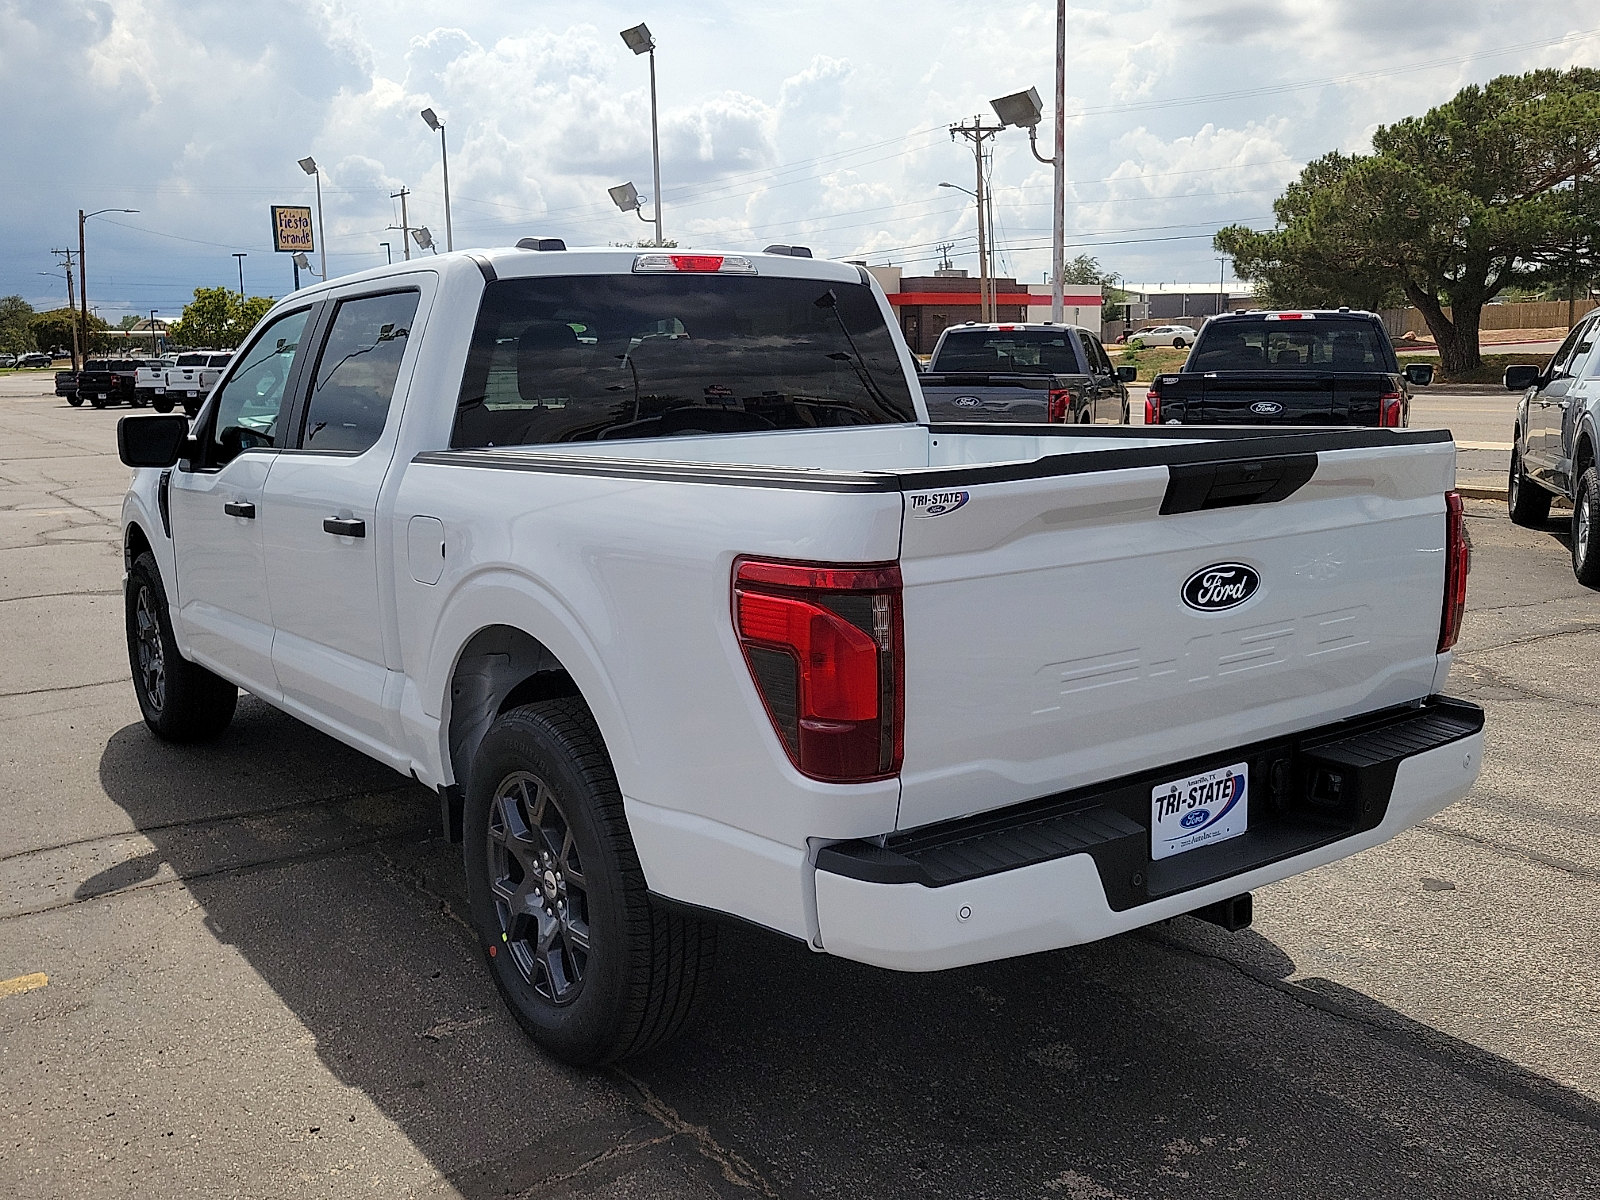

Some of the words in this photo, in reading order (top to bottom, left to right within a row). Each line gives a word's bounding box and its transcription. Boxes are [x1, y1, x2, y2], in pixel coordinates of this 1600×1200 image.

[279, 210, 309, 229] Fiesta
[280, 229, 311, 244] Grande
[1255, 403, 1277, 413] Ford
[911, 492, 960, 509] TRI-STATE
[1198, 571, 1247, 603] Ford
[1155, 778, 1233, 824] TRI-STATE
[1186, 811, 1205, 826] Ford
